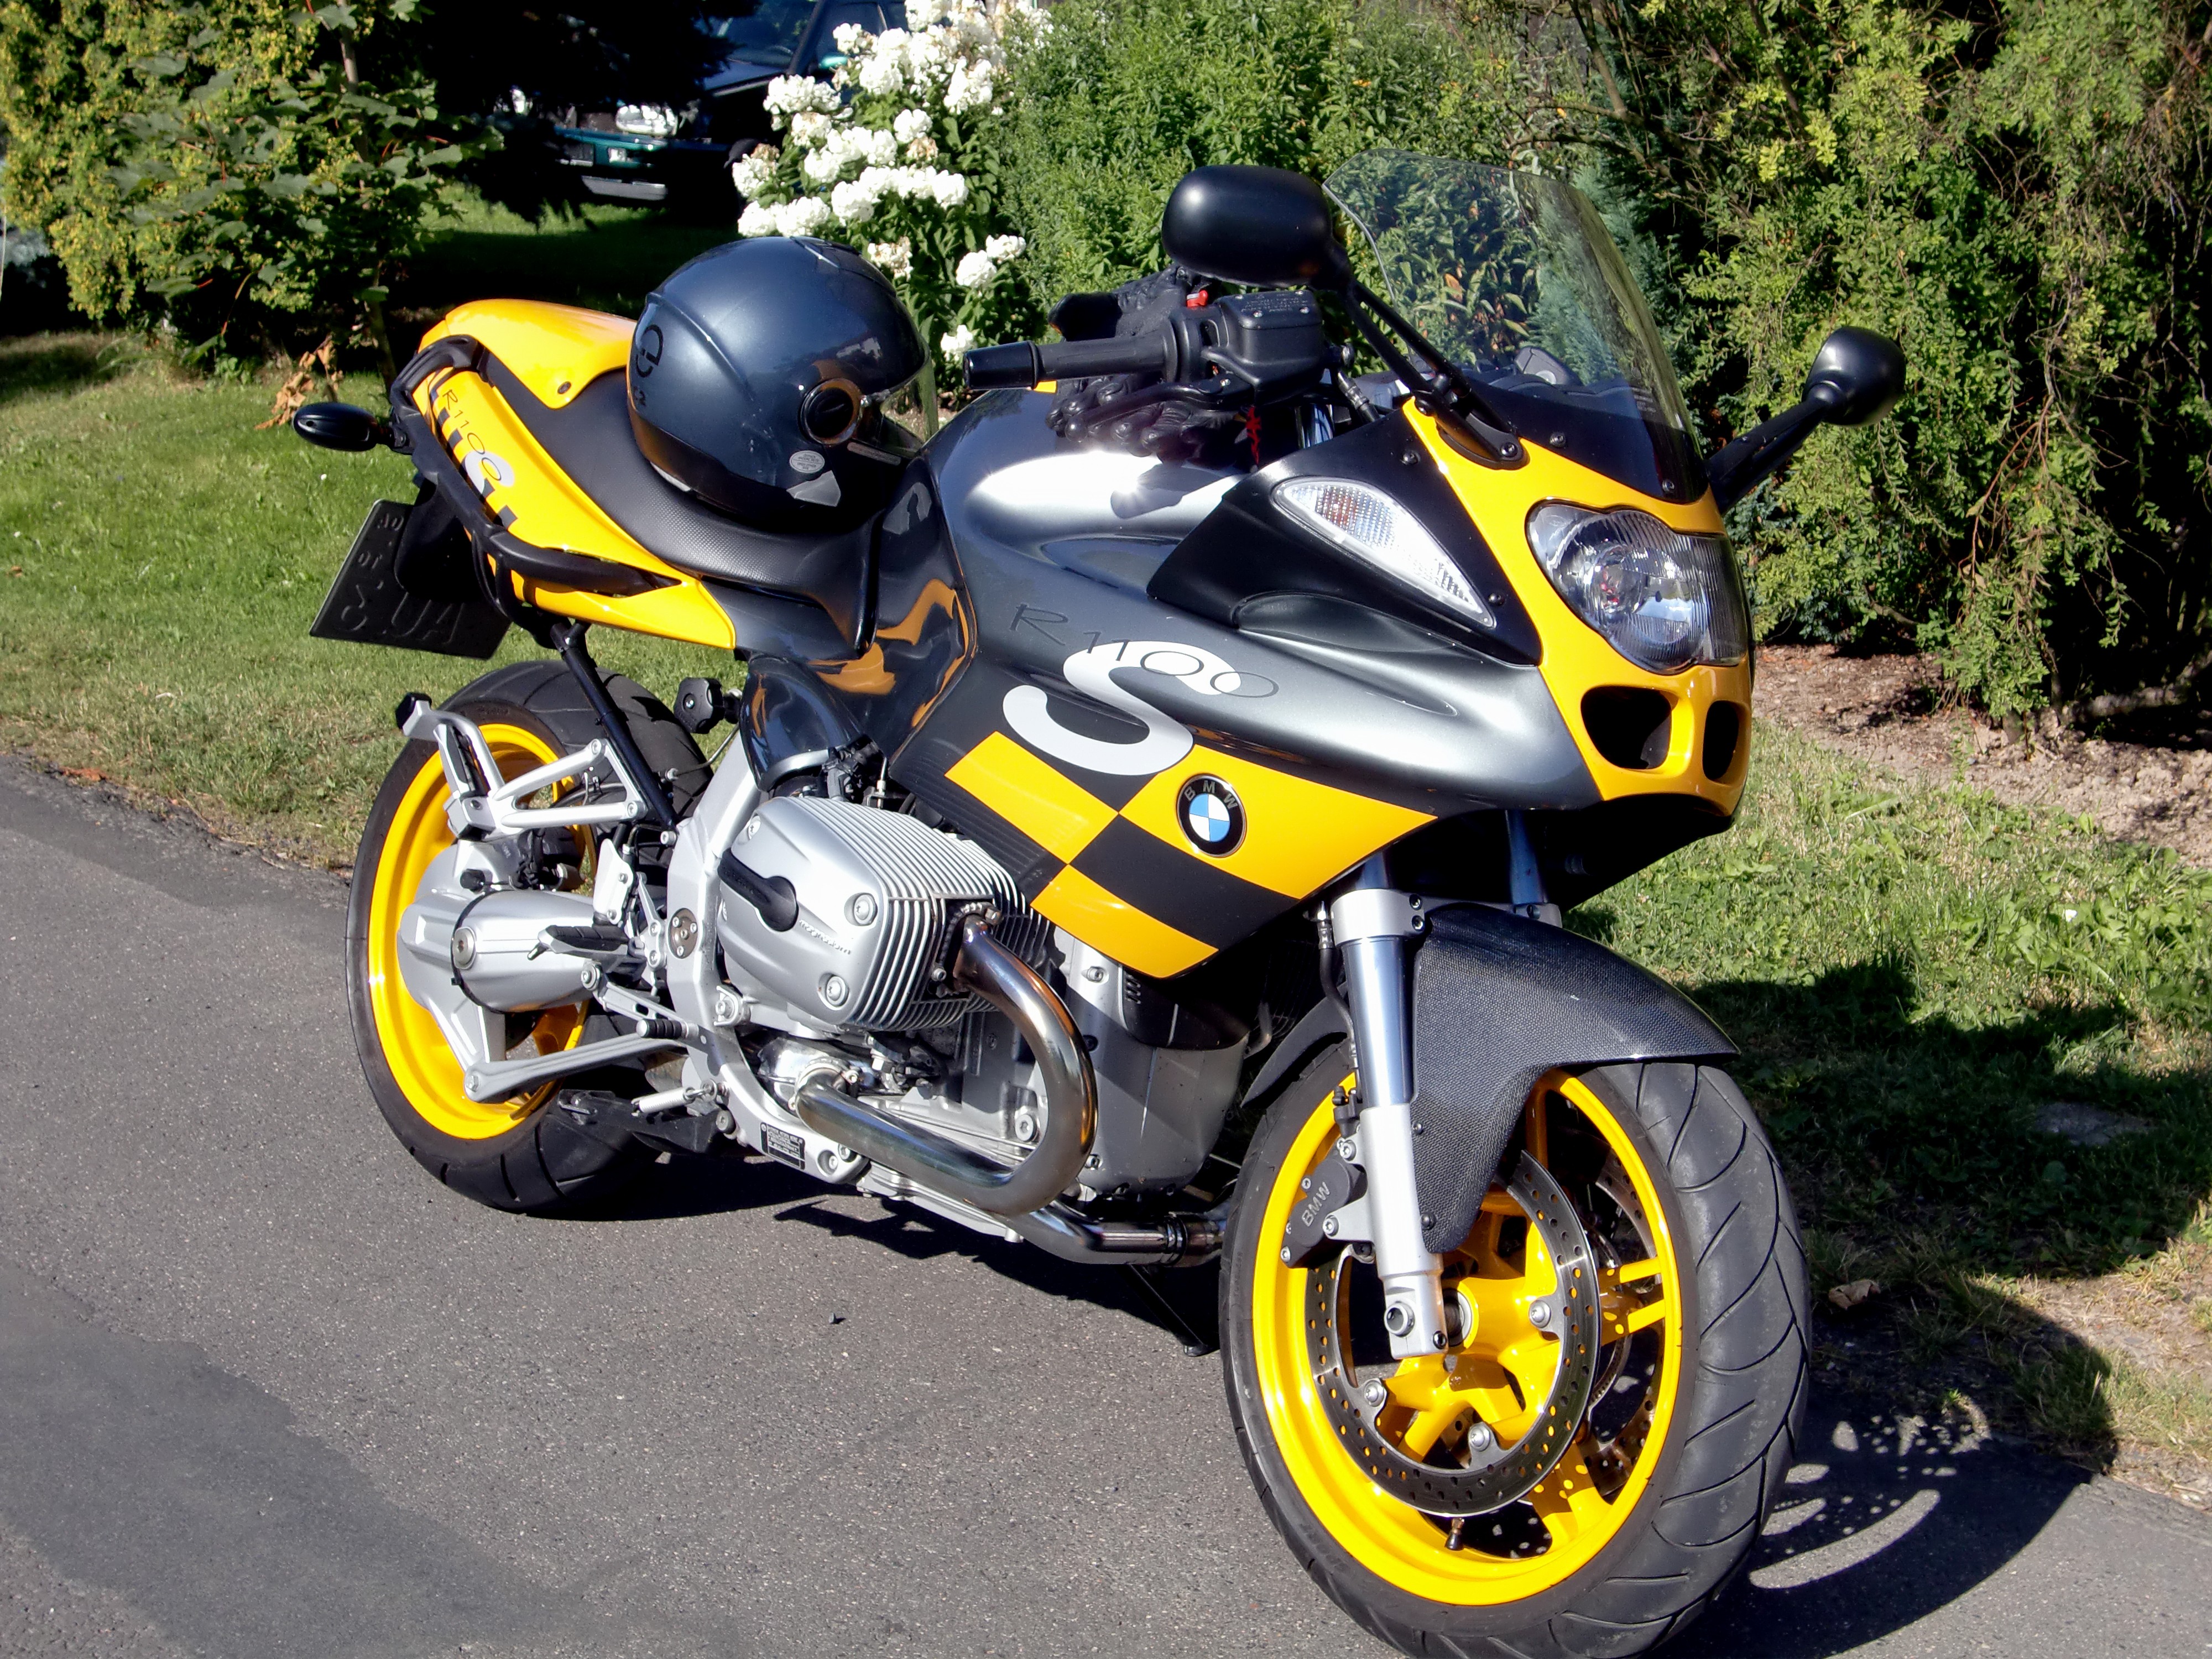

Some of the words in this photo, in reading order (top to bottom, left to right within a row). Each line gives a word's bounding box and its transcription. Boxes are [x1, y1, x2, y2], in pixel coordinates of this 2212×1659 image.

[1003, 640, 1241, 776] S
[1184, 780, 1238, 809] BMW
[1301, 1181, 1330, 1227] BMW
